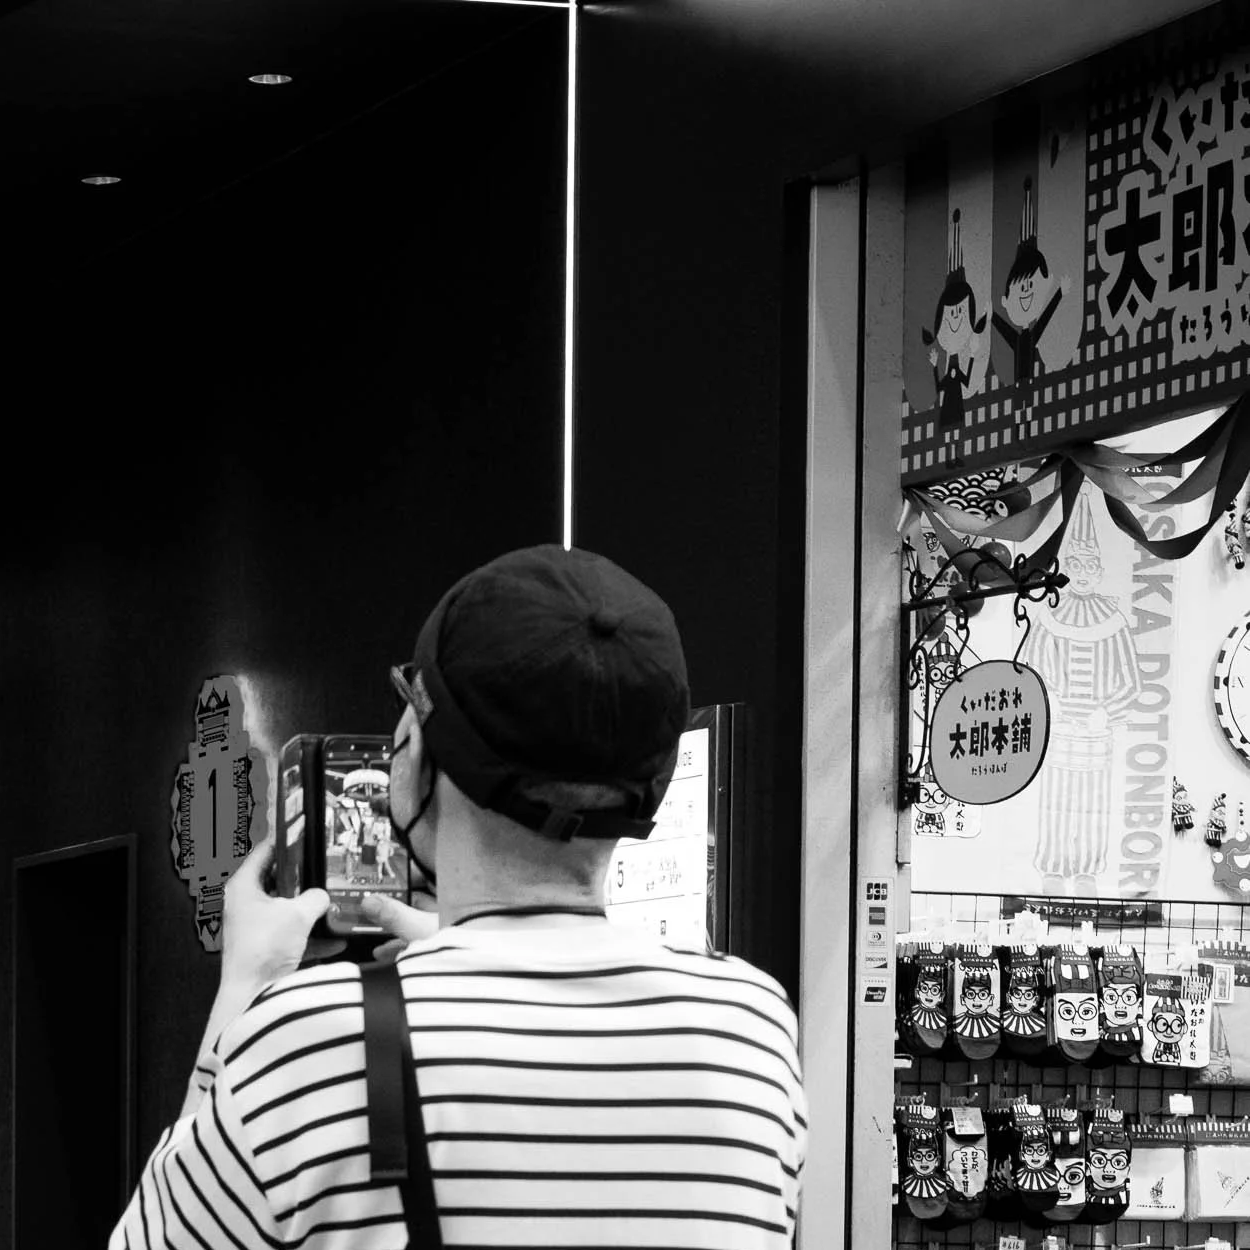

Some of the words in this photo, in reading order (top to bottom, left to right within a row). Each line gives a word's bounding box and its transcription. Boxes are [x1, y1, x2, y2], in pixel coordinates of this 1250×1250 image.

[1105, 160, 1250, 319] 太郎
[960, 687, 1023, 714] くいだおれ
[949, 712, 1032, 760] 太郎本舗
[208, 768, 217, 858] 1
